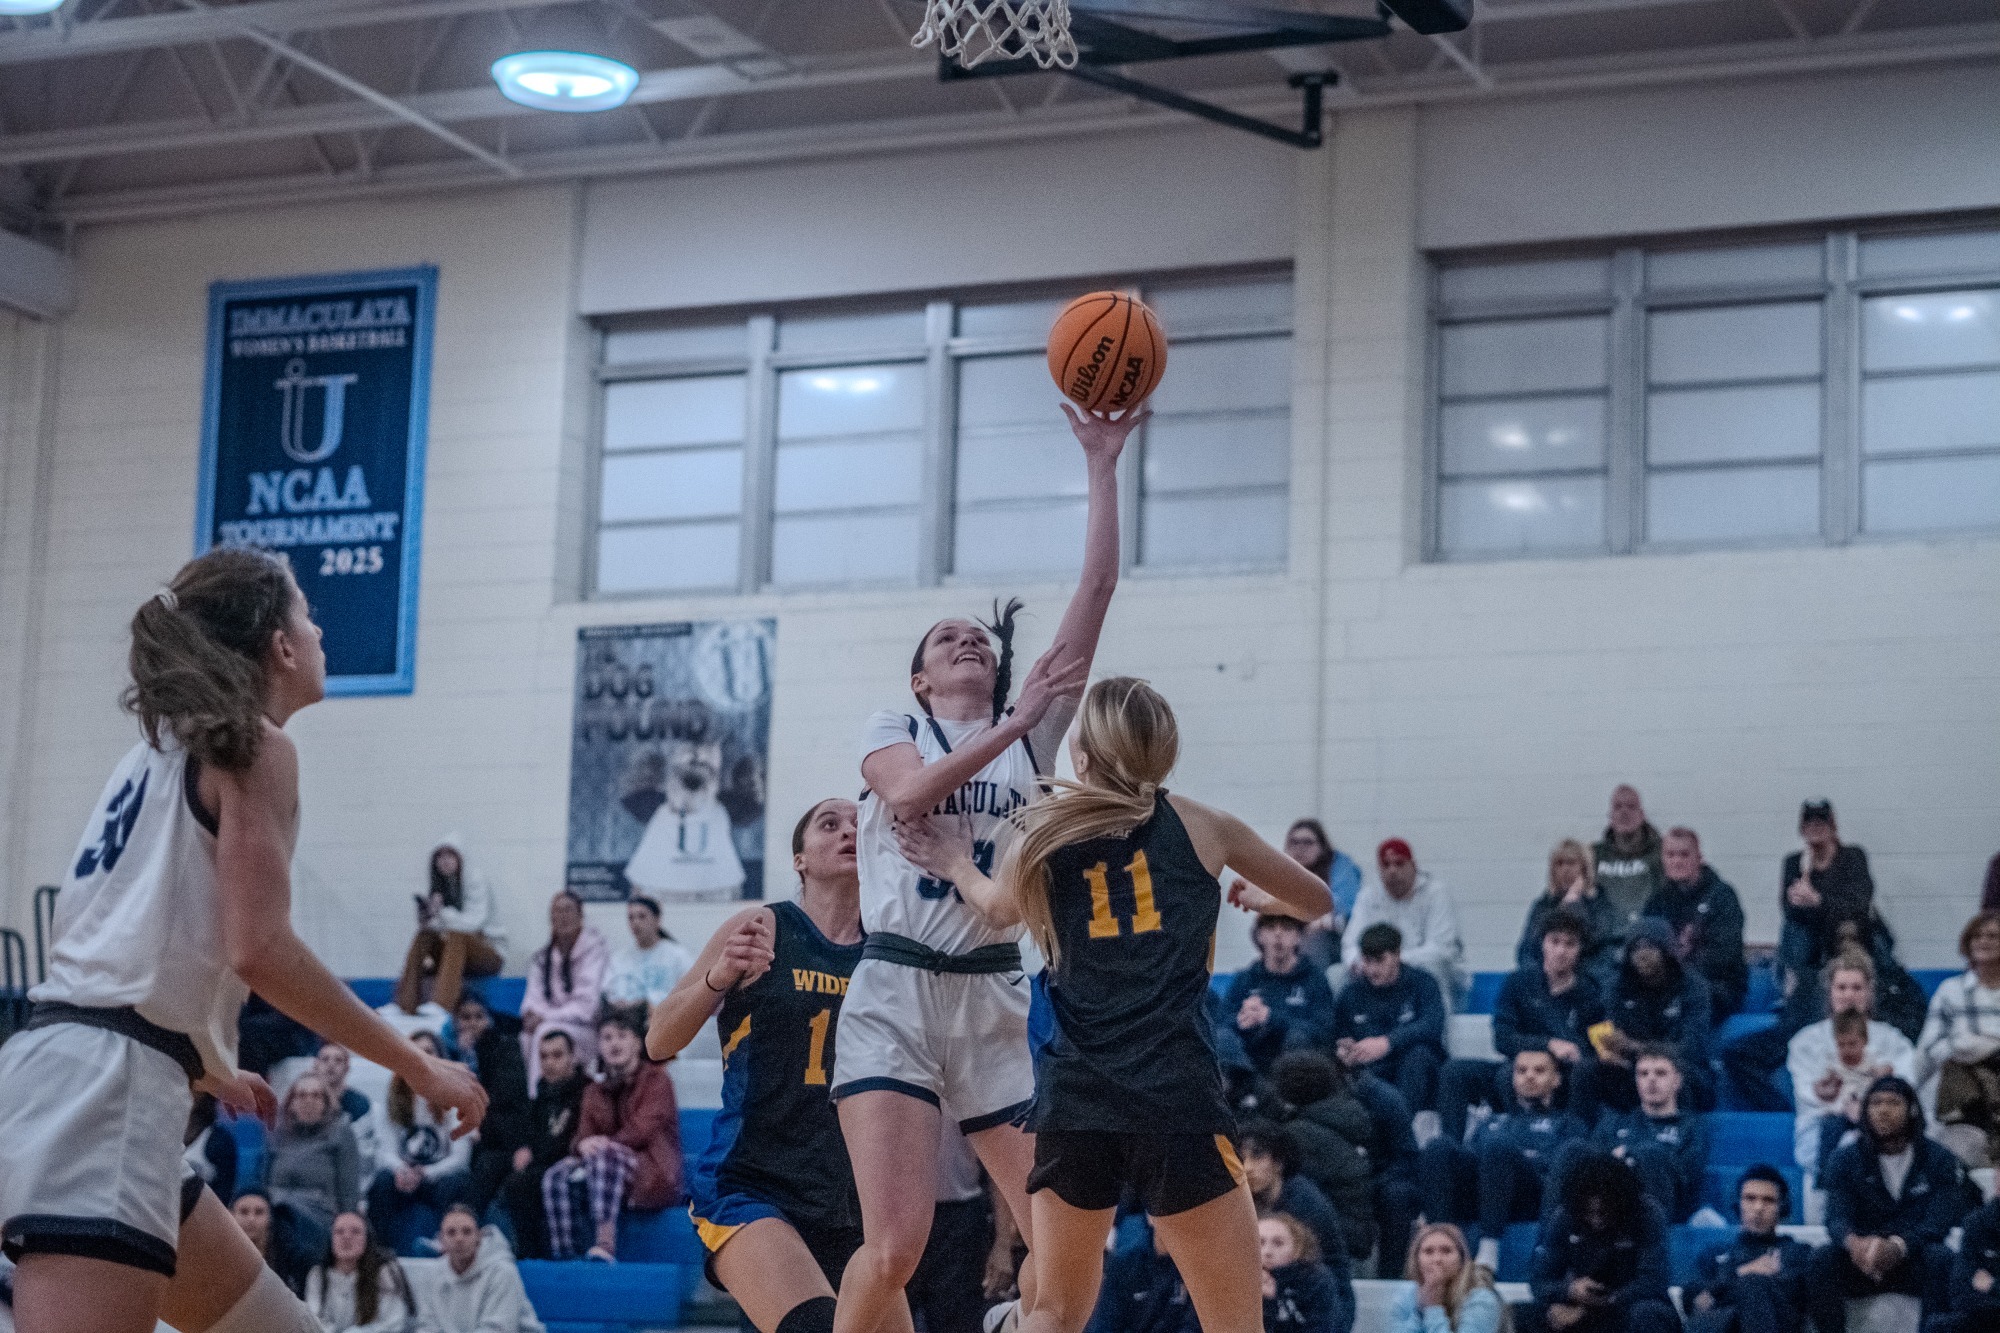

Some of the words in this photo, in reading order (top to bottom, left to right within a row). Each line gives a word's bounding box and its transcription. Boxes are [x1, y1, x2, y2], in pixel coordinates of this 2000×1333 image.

[1070, 335, 1115, 404] Wilson
[1109, 356, 1143, 406] NCAA
[246, 465, 371, 515] NCAA
[219, 511, 399, 550] TOURNAMENT
[319, 546, 385, 577] 2025
[1083, 848, 1161, 938] 11
